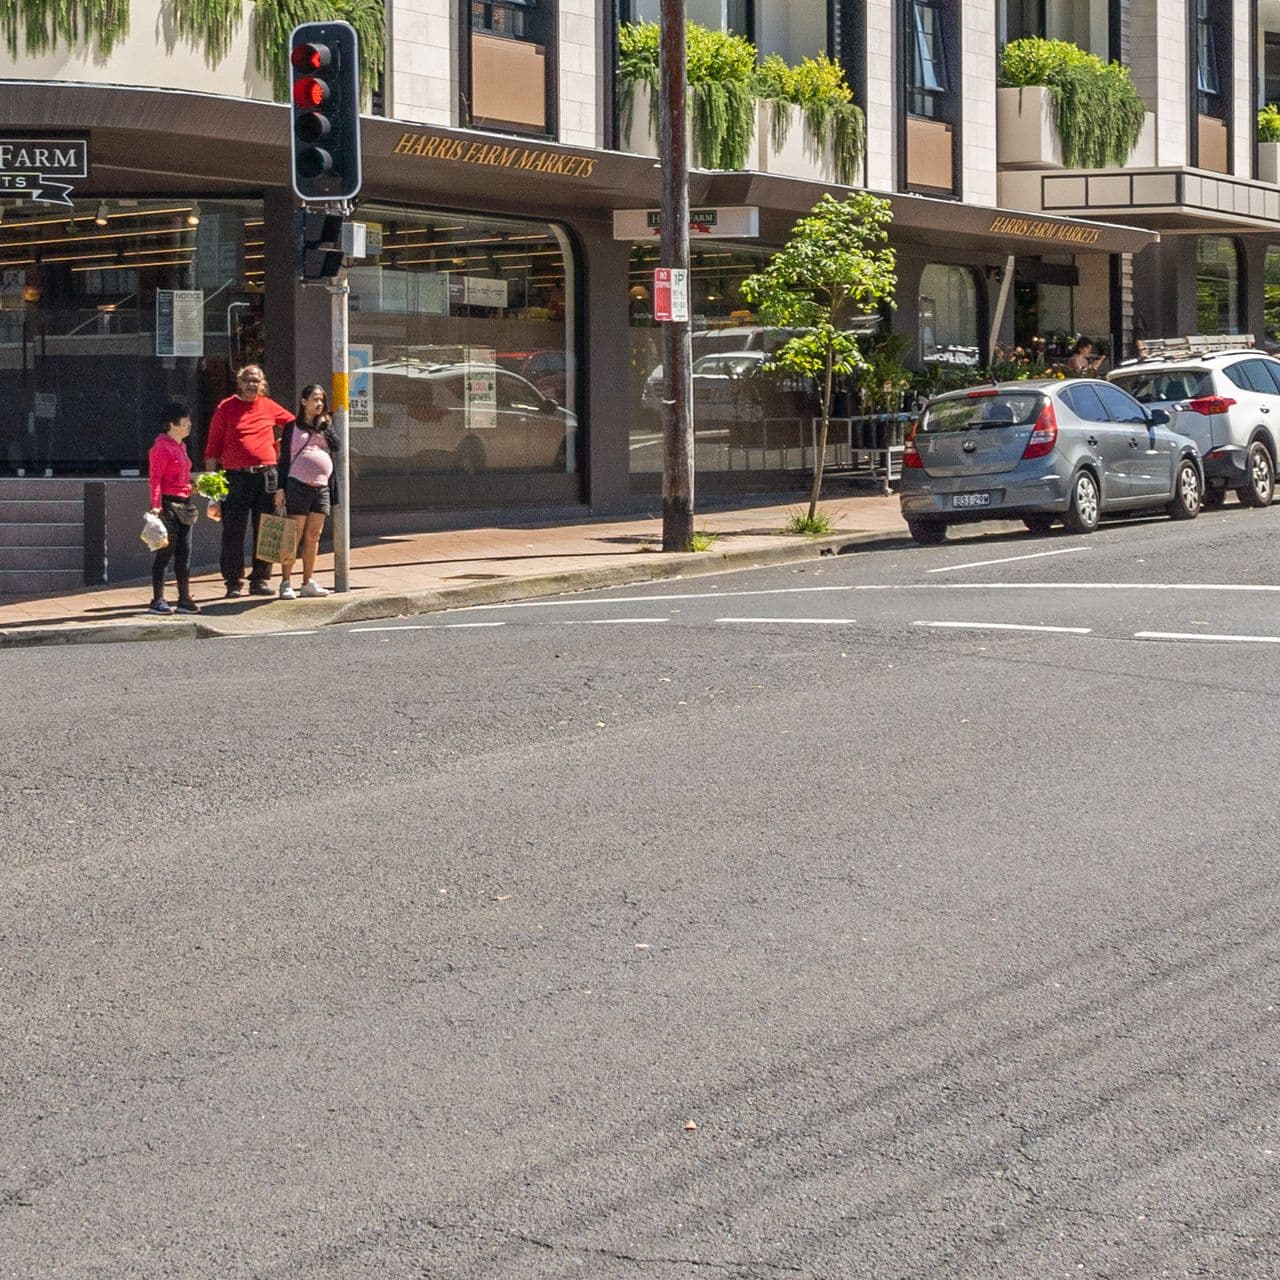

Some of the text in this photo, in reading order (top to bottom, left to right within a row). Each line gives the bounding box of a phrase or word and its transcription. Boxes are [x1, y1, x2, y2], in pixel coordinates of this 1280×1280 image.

[393, 133, 598, 178] HARRIS FARM MARKETS
[989, 217, 1102, 244] HARRIS FARM MARKETS
